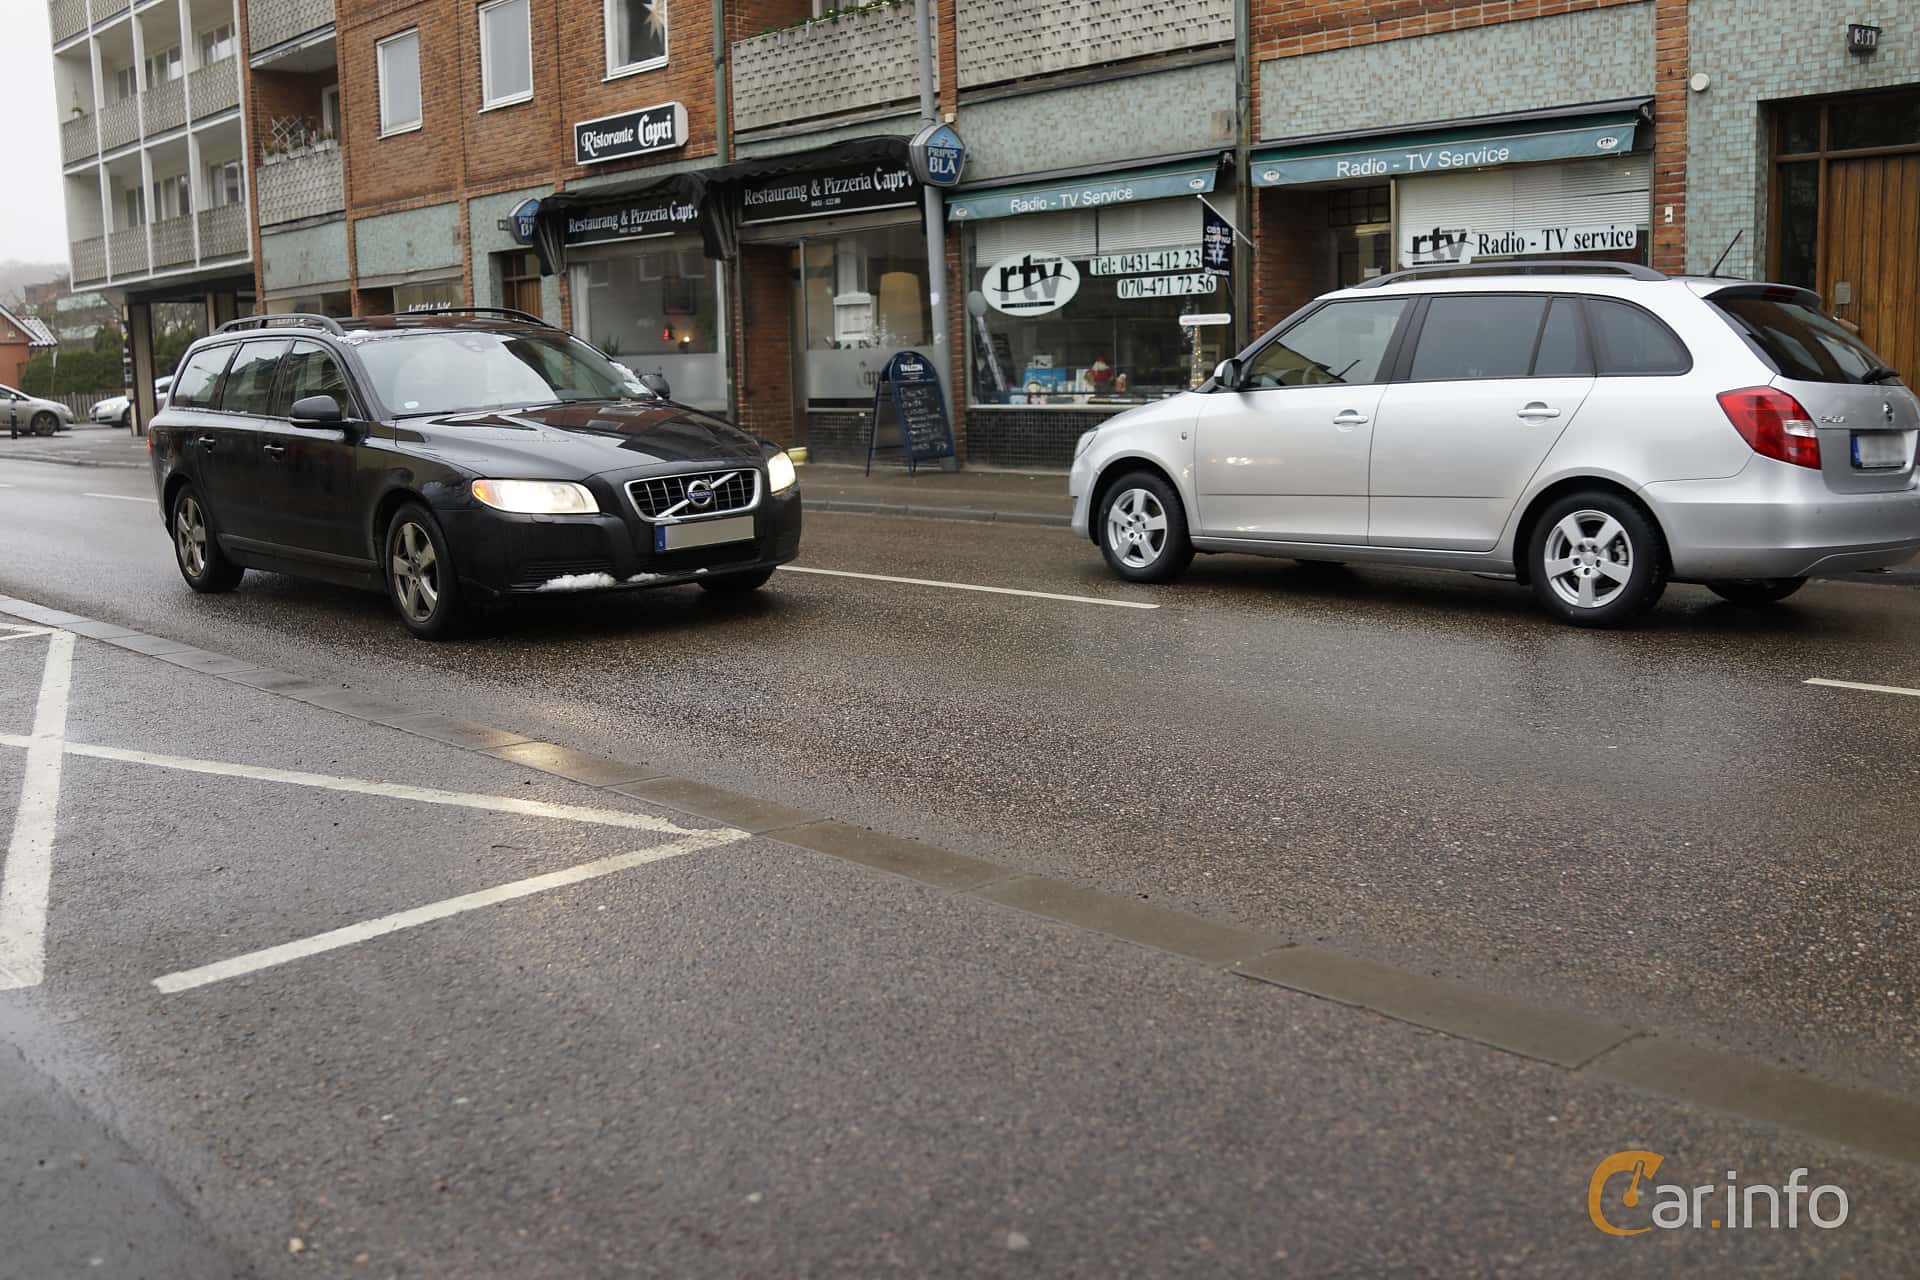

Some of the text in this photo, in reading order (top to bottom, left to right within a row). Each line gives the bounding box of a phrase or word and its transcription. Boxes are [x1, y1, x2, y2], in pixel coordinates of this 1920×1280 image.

[581, 114, 672, 157] Ristorante Capri
[1335, 159, 1388, 177] Radio
[1405, 151, 1433, 171] TV
[1437, 147, 1510, 167] Service
[744, 185, 808, 206] Restaurang
[811, 179, 821, 197] &
[824, 173, 873, 195] Pizzeria
[1010, 196, 1047, 213] Radio
[1060, 193, 1080, 208] TV
[1082, 187, 1134, 204] Service
[568, 213, 618, 233] Restaurang
[620, 209, 629, 226] &
[631, 204, 669, 225] Pizzeria
[1411, 227, 1468, 260] rtv
[1478, 231, 1525, 255] Radio
[1542, 228, 1569, 251] TV
[1574, 225, 1634, 249] service
[1094, 257, 1116, 274] Tel:
[1121, 251, 1180, 273] 0431-412
[1186, 250, 1200, 267] 23
[1000, 254, 1063, 301] rtv
[1121, 274, 1213, 297] 070-471 72 56
